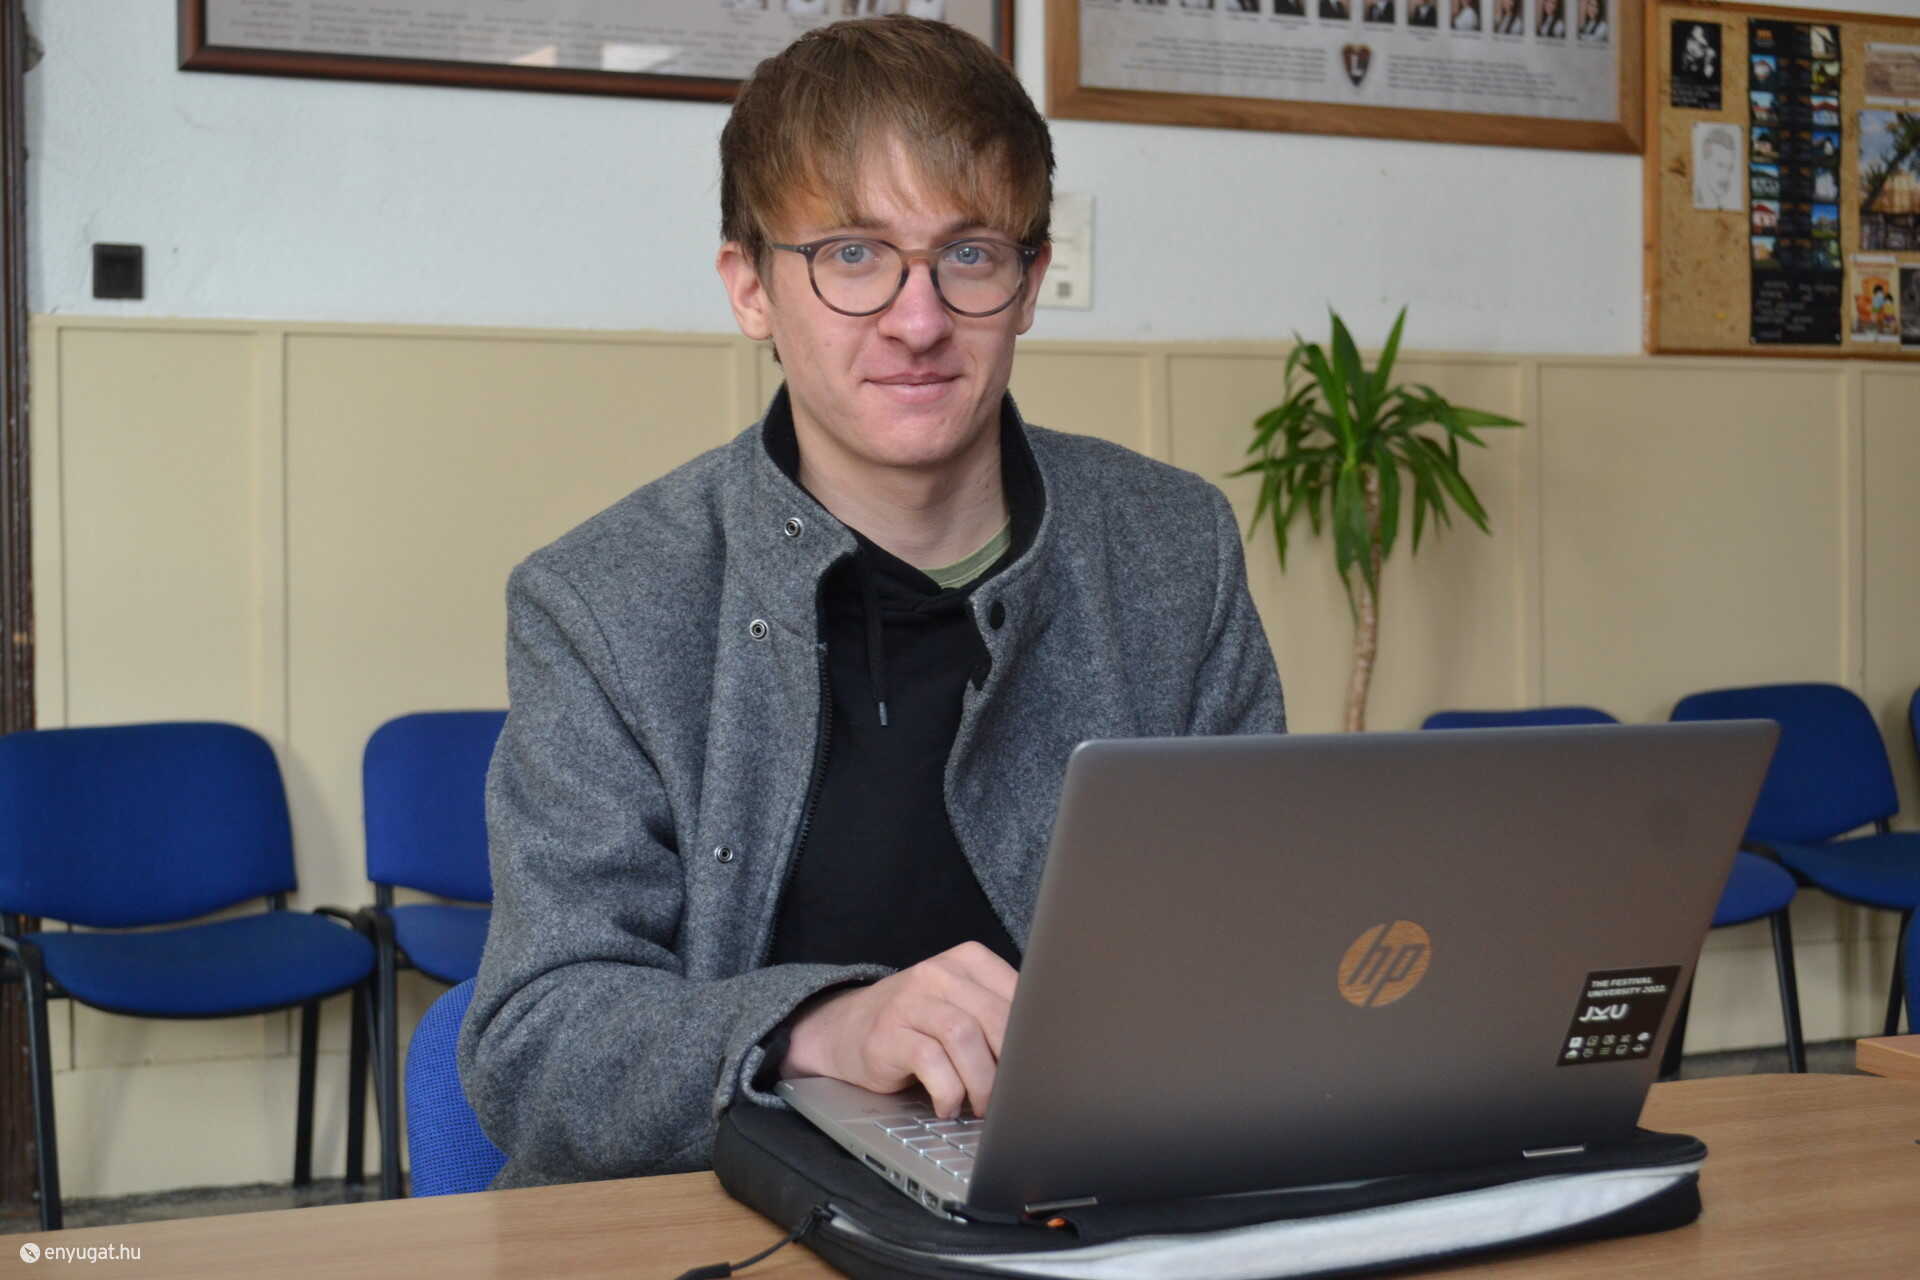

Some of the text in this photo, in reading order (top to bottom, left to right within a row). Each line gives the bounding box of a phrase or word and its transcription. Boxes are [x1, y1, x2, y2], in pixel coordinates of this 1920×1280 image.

[1591, 977, 1653, 988] THE FESTIVAL
[1587, 987, 1641, 997] UNIVERSITY
